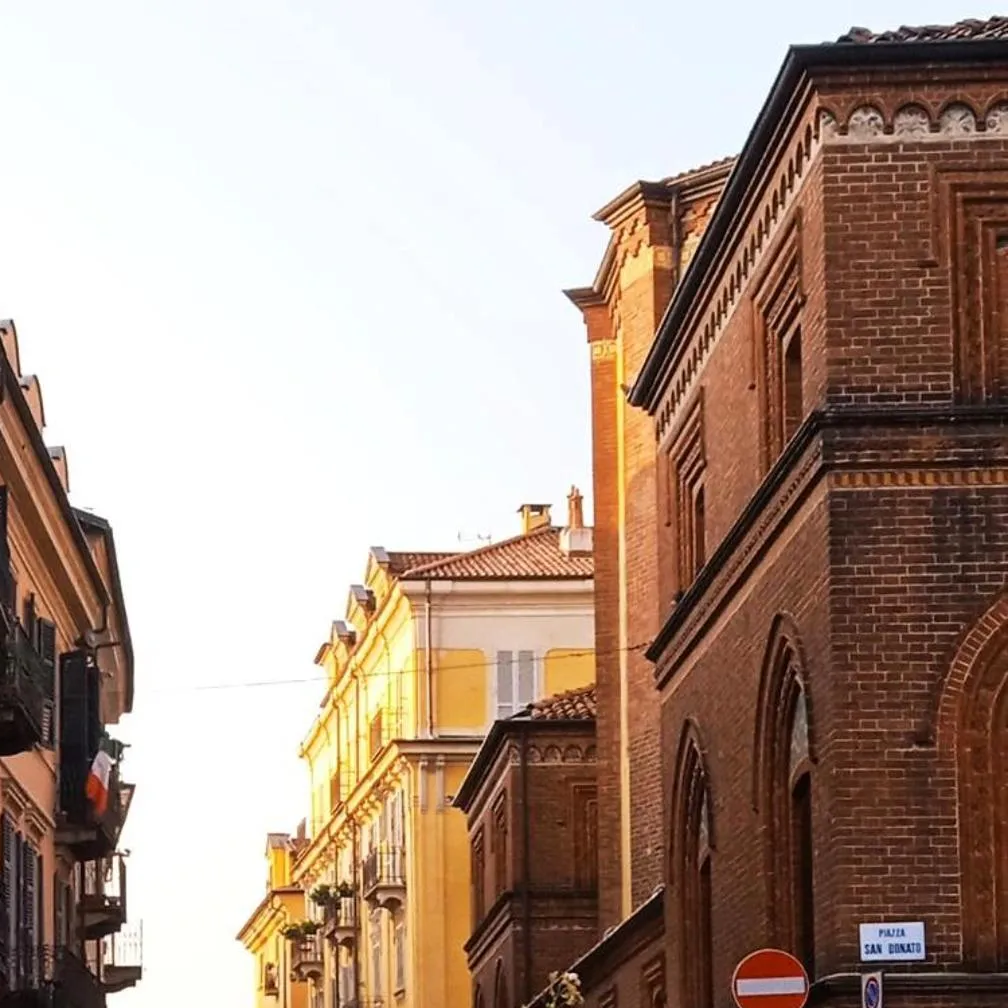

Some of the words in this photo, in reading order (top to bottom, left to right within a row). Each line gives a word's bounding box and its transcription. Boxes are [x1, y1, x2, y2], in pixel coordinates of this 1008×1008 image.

[878, 928, 905, 938] PIAZZA
[864, 943, 882, 955] SAN
[888, 942, 922, 955] DONATO
